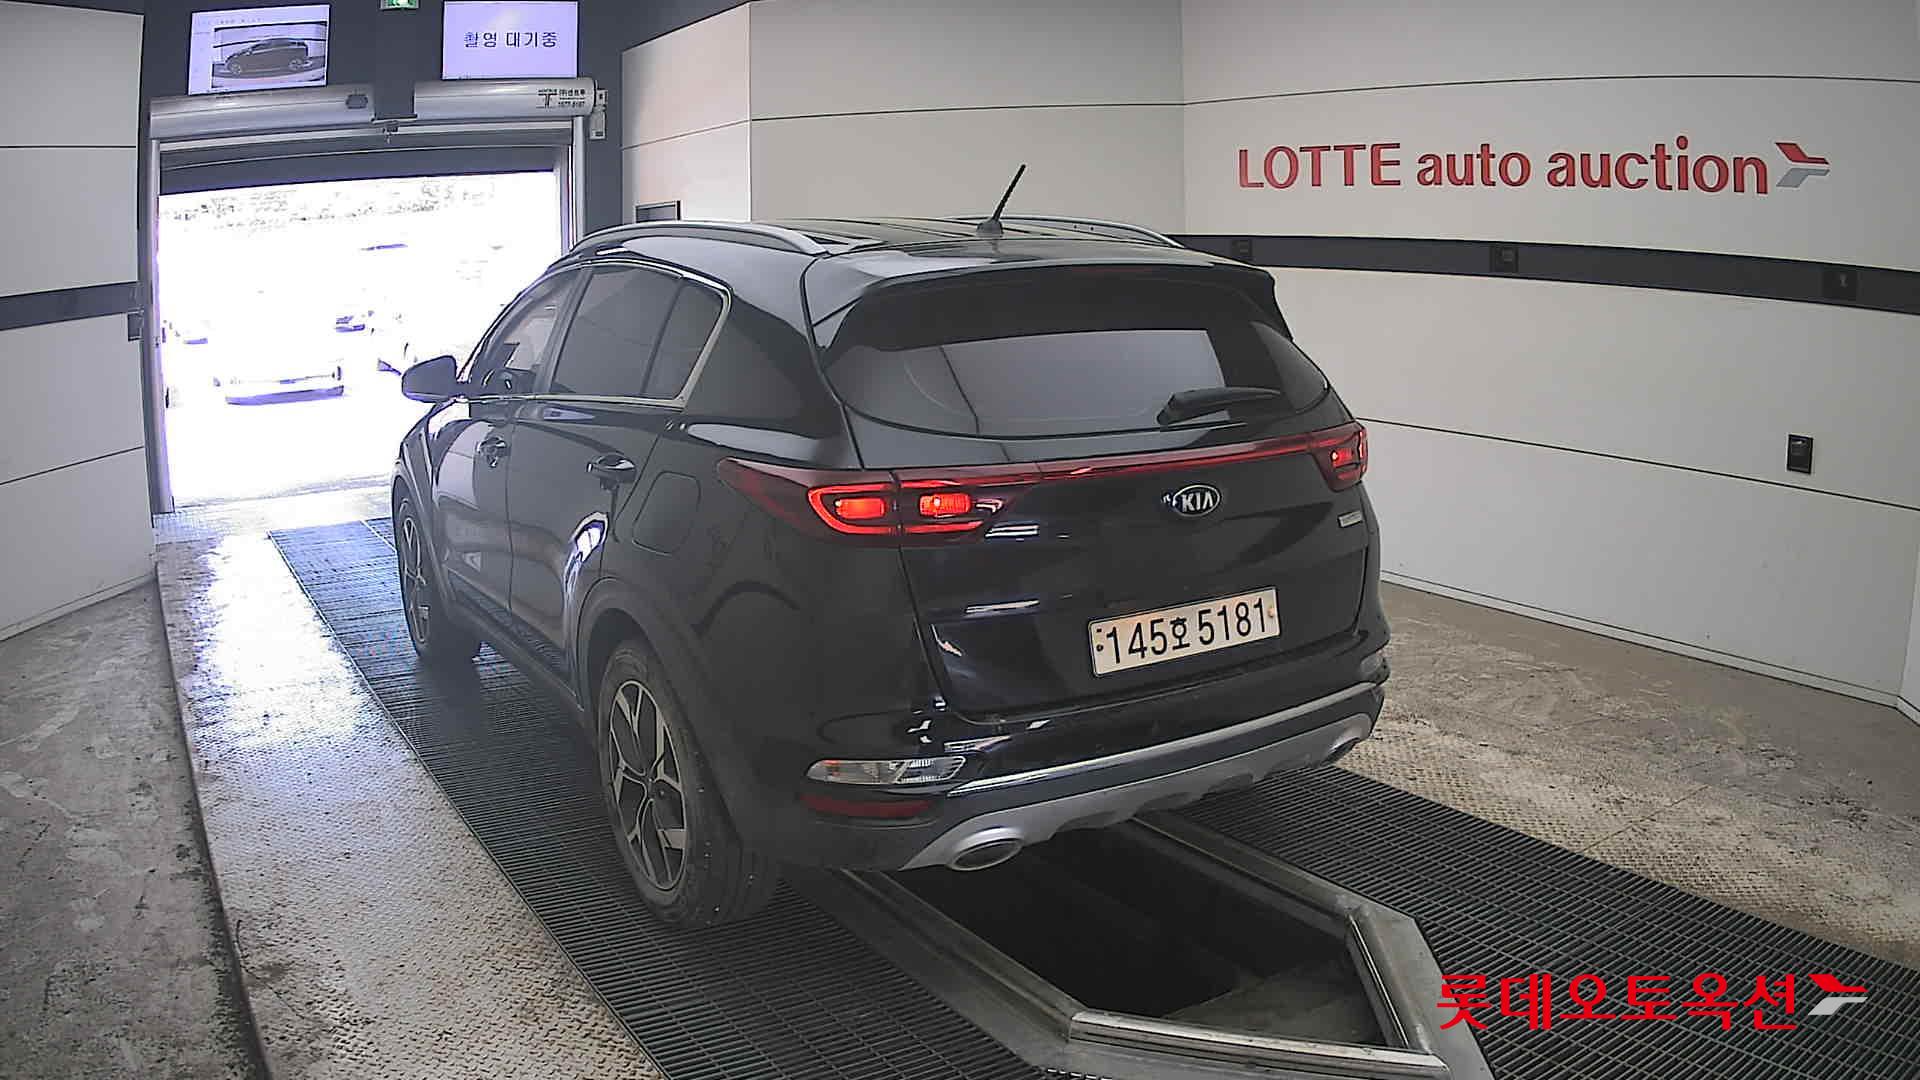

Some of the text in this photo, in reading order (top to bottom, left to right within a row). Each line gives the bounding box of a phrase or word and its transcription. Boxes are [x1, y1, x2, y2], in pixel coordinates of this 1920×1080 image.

[464, 31, 557, 48] 촬영 대기중
[1238, 136, 1769, 194] LOTTE auto auction
[1181, 491, 1213, 513] KIA
[1198, 597, 1266, 645] 5181
